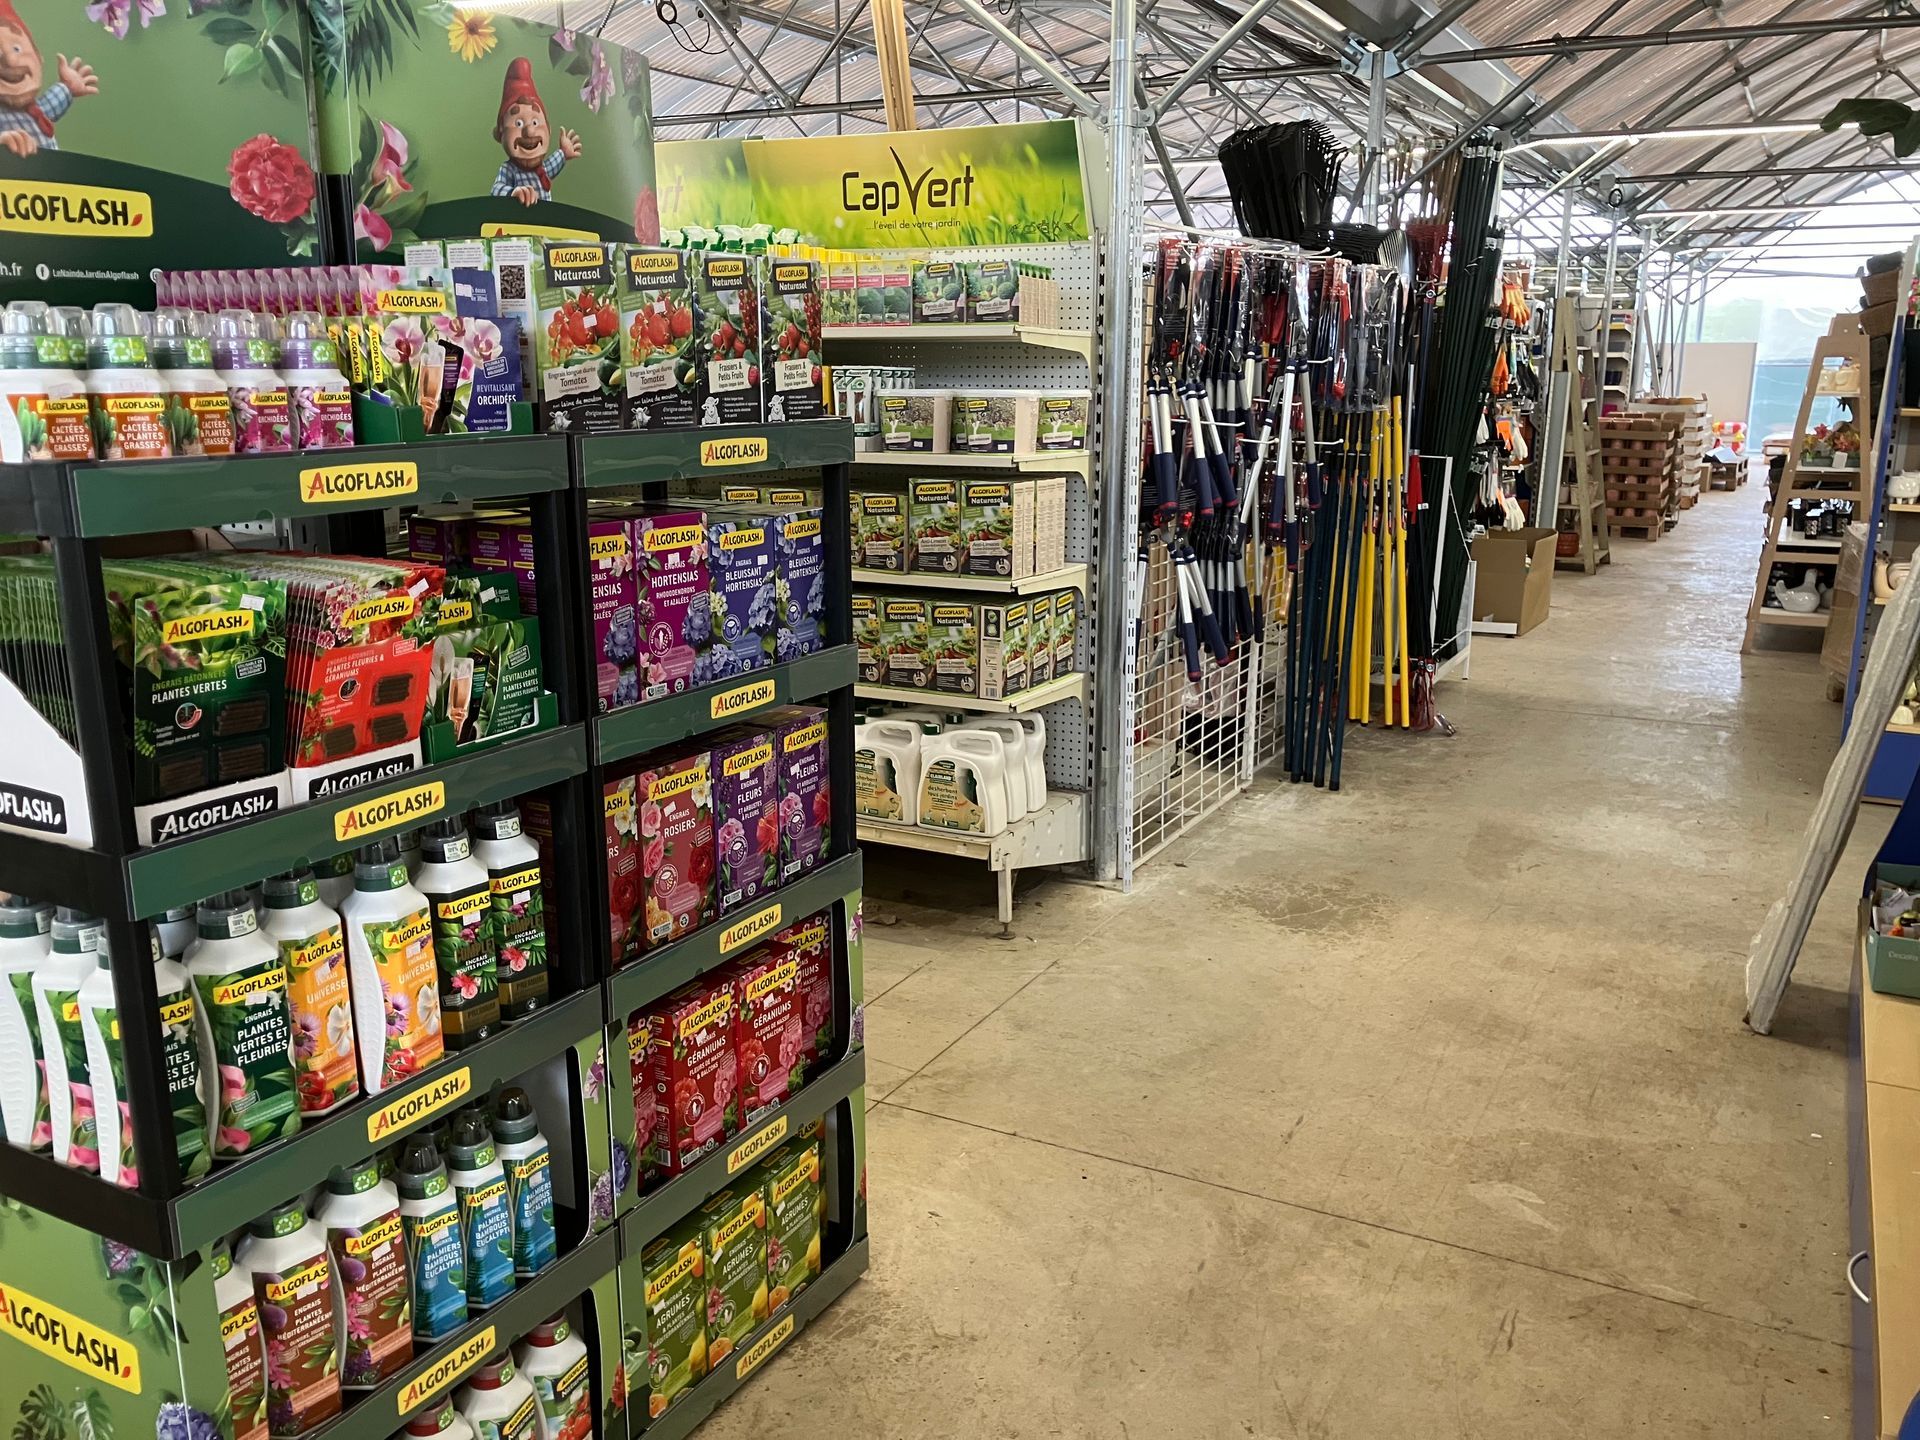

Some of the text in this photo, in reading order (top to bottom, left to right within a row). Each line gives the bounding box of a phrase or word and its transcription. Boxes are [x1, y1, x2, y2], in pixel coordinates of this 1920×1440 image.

[0, 192, 129, 226] LGOFLASH
[900, 220, 910, 229] de
[912, 221, 933, 230] votre
[935, 218, 961, 230] jardin
[553, 251, 598, 265] ALGOFLASH
[635, 257, 673, 269] ALGOFLASH
[554, 269, 601, 282] Naturasol
[711, 262, 740, 273] ALGOFLASH
[778, 268, 806, 280] ALGOFLASH
[635, 274, 676, 286] Naturasol
[712, 277, 743, 287] Naturasol
[779, 282, 808, 291] Naturasol
[381, 292, 438, 308] ALGOFLASH
[349, 330, 360, 378] ALGOFLASH
[371, 328, 381, 380] ALGOFLASH
[560, 376, 588, 387] Tomates
[640, 375, 665, 385] Tomates
[718, 370, 744, 380] Petits Fruits
[784, 370, 807, 380] Petits Fruits
[317, 392, 350, 401] ALGOFLASH
[476, 383, 516, 393] REVITALISANT
[42, 401, 86, 411] ALGOFLASH
[111, 400, 160, 410] ALGOFLASH
[194, 399, 228, 409] ALGOFLASH
[253, 394, 286, 403] ALGOFLASH
[477, 393, 517, 406] ORCHIDÉES
[201, 420, 227, 429] CACTÉES
[258, 412, 288, 423] ORCHIDÉES
[320, 411, 352, 421] ORCHIDÉES
[51, 424, 85, 434] CACTÉES
[121, 421, 158, 432] CACTÉES
[205, 429, 231, 438] PLANTES
[57, 434, 90, 443] PLANTES
[123, 440, 161, 450] GRASSES
[127, 432, 163, 441] PLANTES
[203, 437, 229, 446] GRASSES
[53, 443, 87, 452] GRASSES
[704, 443, 761, 464] ALGOFLASH
[308, 469, 405, 498] ALGOFLASH
[775, 494, 800, 502] ALGOFLASH
[786, 523, 817, 538] ALGOFLASH
[591, 540, 618, 555] FLASH
[648, 531, 696, 550] ALGOFLASH
[722, 533, 761, 548] ALGOFLASH
[664, 560, 686, 570] ENGRAIS
[735, 559, 752, 568] ENGRAIS
[788, 555, 819, 568] BLEUISSANT
[651, 570, 699, 588] HORTENSIAS
[725, 567, 762, 581] BLEUISSANT
[788, 566, 819, 579] HORTENSIAS
[593, 582, 622, 599] ENSIAS
[655, 585, 696, 599] RHODODENDRONS
[725, 578, 763, 592] HORTENSIAS
[670, 596, 690, 607] AZALÉES
[345, 601, 405, 625] ALGOFLASH
[440, 606, 465, 620] FLASH
[168, 615, 242, 641] ALGOFLASH
[326, 662, 350, 674] PLANTES
[352, 656, 379, 668] FLEURIES
[152, 677, 182, 691] ENGRAIS
[324, 668, 359, 683] GÉRANIUMS
[502, 668, 538, 683] REVITALISANT
[152, 679, 228, 704] PLANTES VERTES
[503, 678, 539, 693] PLANTES VERTES
[507, 690, 522, 700] PLANTES
[715, 686, 768, 717] ALGOFLASH
[787, 728, 823, 750] ALGOFLASH
[726, 749, 767, 774] ALGOFLASH
[796, 763, 819, 779] FLEURS
[652, 771, 700, 798] ALGOFLASH
[740, 778, 759, 790] ENGRAIS
[737, 787, 763, 805] FLEURS
[159, 796, 264, 841] ALGOFLASH
[342, 791, 432, 837] ALGOFLASH
[669, 809, 690, 822] ENGRAIS
[745, 809, 760, 819] FLEURS
[664, 818, 696, 838] ROSIERS
[443, 894, 490, 916] ALGOFLAS
[388, 919, 431, 947] ALGOFLAS
[514, 928, 537, 940] ENGRAIS
[723, 911, 775, 949] ALGOFLASH
[296, 939, 342, 967] ALGOFLAS
[465, 953, 488, 966] ENGRAIS
[218, 973, 284, 1004] ALGOFLASH
[750, 966, 791, 998] ALGOFLASH
[244, 1008, 273, 1024] ENGRAIS
[683, 1000, 726, 1035] ALGOFLASH
[753, 1000, 792, 1029] GÉRANIUMS
[237, 1017, 284, 1041] PLANTES
[756, 1013, 790, 1038] FLEURS DE MASSIF
[766, 1024, 784, 1041] BALCONS
[233, 1026, 288, 1055] VERTES ET
[237, 1040, 288, 1067] FLEURIES
[687, 1035, 726, 1067] GÉRANIUMS
[183, 1061, 195, 1074] ET
[689, 1049, 725, 1077] FLEURS DE MASSIF
[700, 1061, 719, 1078] BALCONS
[374, 1077, 459, 1138] ALGOFLASH
[730, 1122, 781, 1172] ALGOFLASH
[775, 1163, 811, 1199] ALGOFLASH
[523, 1189, 550, 1210] BAMBOUS
[526, 1181, 551, 1202] PALMIERS
[781, 1197, 808, 1227] AGRUMES
[475, 1219, 507, 1240] BAMBOUS
[478, 1210, 508, 1232] PALMIERS
[715, 1207, 755, 1248] ALGOFLASH
[351, 1221, 400, 1252] ALGOFLAS
[426, 1240, 461, 1263] PALMIERS
[722, 1243, 753, 1275] AGRUMES
[371, 1252, 395, 1270] ENGRAIS
[424, 1250, 459, 1271] BAMBOUS
[372, 1261, 397, 1279] PLANTES
[648, 1256, 692, 1301] ALGOFLASH
[270, 1266, 327, 1299] ALGOFLAS
[294, 1298, 322, 1317] ENGRAIS
[656, 1293, 690, 1329] AGRUMES
[295, 1308, 323, 1326] PLANTES
[666, 1311, 686, 1330] PLANTES
[740, 1322, 788, 1377] ALGOFLASH
[403, 1337, 485, 1411] ALGOFLASH
